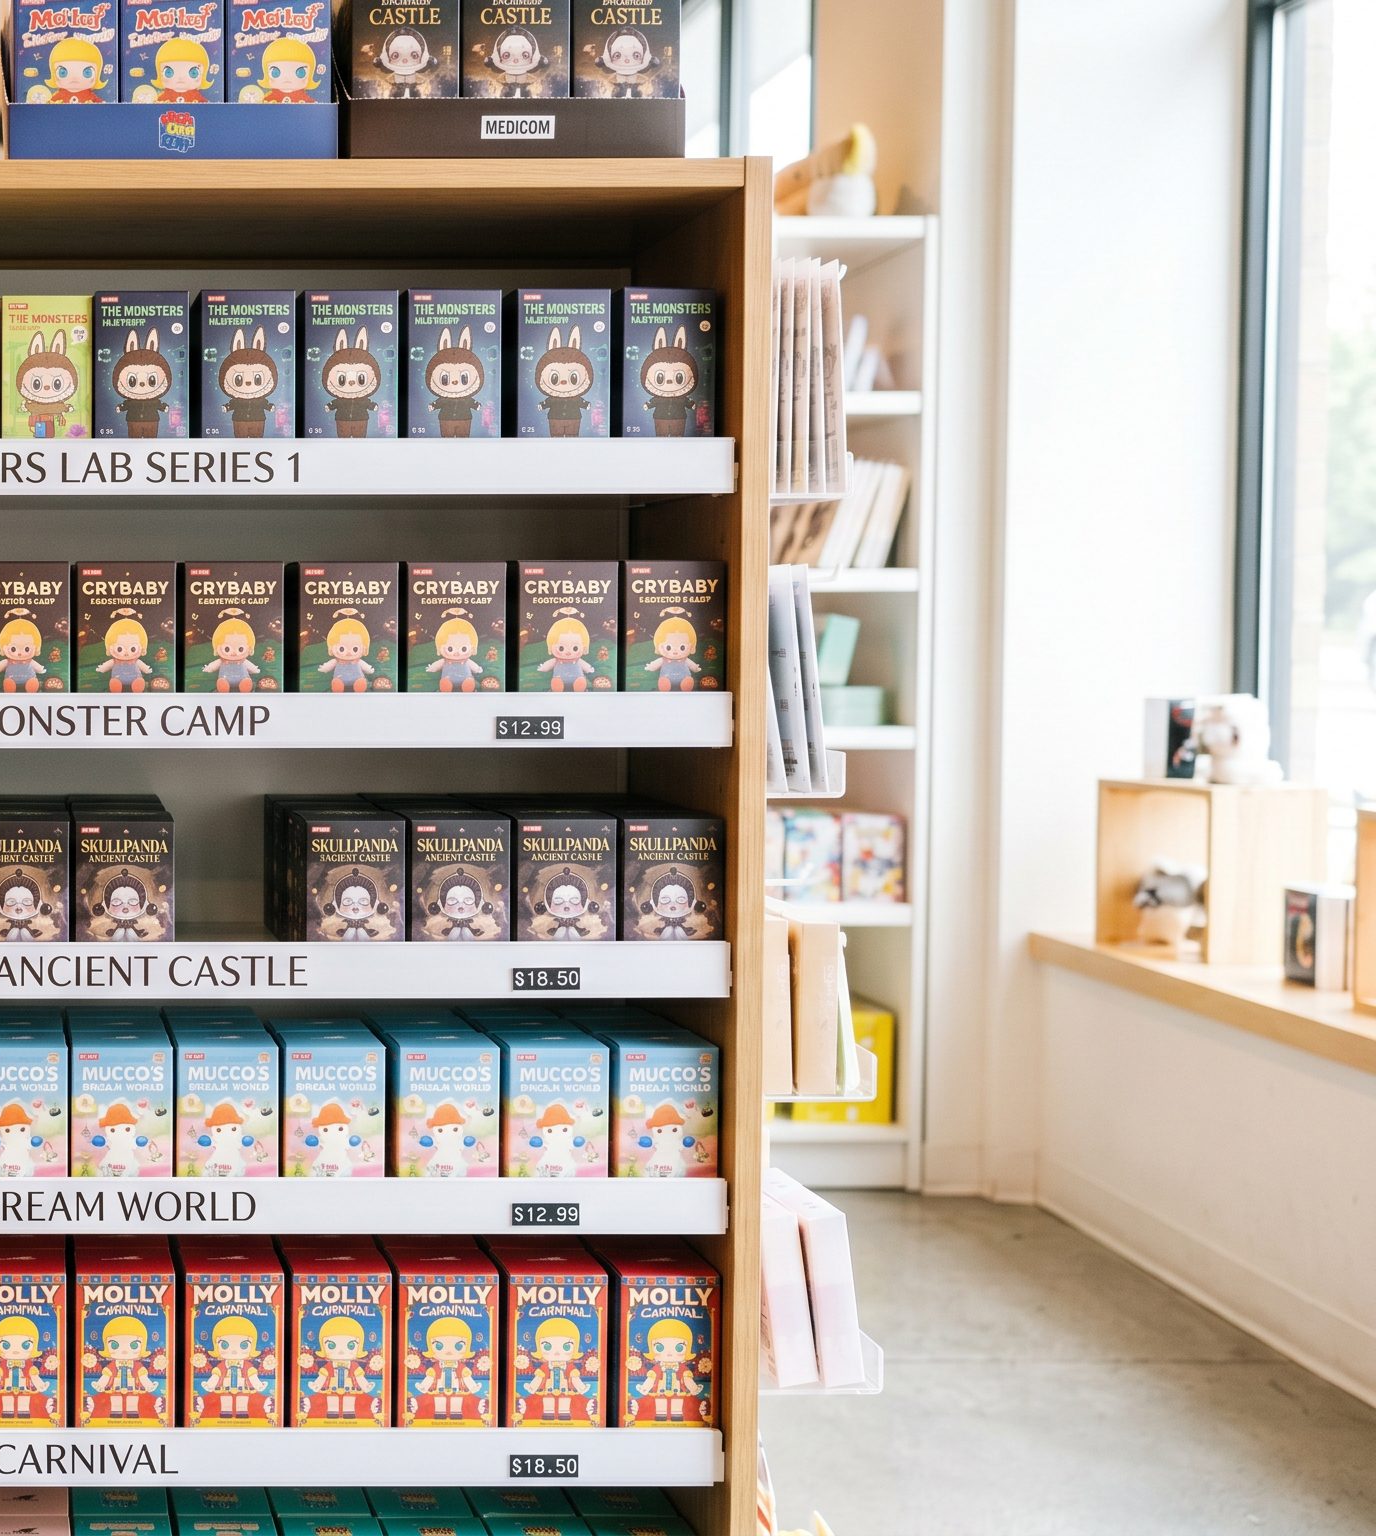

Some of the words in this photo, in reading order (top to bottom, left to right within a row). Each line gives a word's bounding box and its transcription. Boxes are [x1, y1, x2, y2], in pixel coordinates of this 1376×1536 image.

[369, 8, 441, 25] CASTLE
[480, 8, 552, 25] CASTLE
[590, 8, 662, 25] CASTLE
[486, 121, 550, 134] MEDICOM
[101, 306, 121, 316] THE
[208, 305, 228, 315] THE
[231, 305, 289, 315] MONSTERS
[311, 305, 332, 315] THE
[334, 305, 393, 315] MONSTERS
[414, 304, 434, 315] THE
[437, 304, 496, 315] MONSTERS
[524, 303, 544, 314] THE
[547, 303, 605, 314] MONSTERS
[630, 303, 650, 314] THE
[653, 303, 711, 314] MONSTERS
[32, 314, 87, 323] MONSTERS
[62, 452, 132, 483] LAB
[146, 452, 273, 483] SERIES
[288, 452, 298, 483] 1
[82, 581, 169, 595] CRYBABY
[190, 581, 277, 595] CRYBABY
[305, 581, 391, 595] CRYBABY
[413, 581, 500, 595] CRYBABY
[524, 580, 611, 594] CRYBABY
[631, 579, 718, 594] CRYBABY
[161, 706, 269, 736] CAMP
[81, 839, 168, 853] SKULLPANDA
[311, 839, 399, 853] SKULLPANDA
[417, 838, 504, 852] SKULLPANDA
[523, 838, 610, 852] SKULLPANDA
[630, 837, 717, 851] SKULLPANDA
[531, 853, 569, 861] ANCIENT
[169, 956, 307, 986] CASTLE
[82, 1066, 164, 1082] MUCCO'S
[188, 1066, 270, 1082] MUCCO'S
[295, 1066, 376, 1082] MUCCO'S
[409, 1066, 491, 1082] MUCCO'S
[520, 1067, 601, 1082] MUCCO'S
[629, 1066, 711, 1082] MUCCO'S
[118, 1191, 255, 1221] WORLD
[84, 1285, 168, 1304] MOLLY
[193, 1285, 278, 1305] MOLLY
[301, 1285, 385, 1304] MOLLY
[408, 1285, 492, 1305] MOLLY
[517, 1286, 601, 1305] MOLLY
[629, 1288, 713, 1306] MOLLY
[641, 1307, 703, 1318] CARNIVAL
[512, 1457, 577, 1475] $18.50
